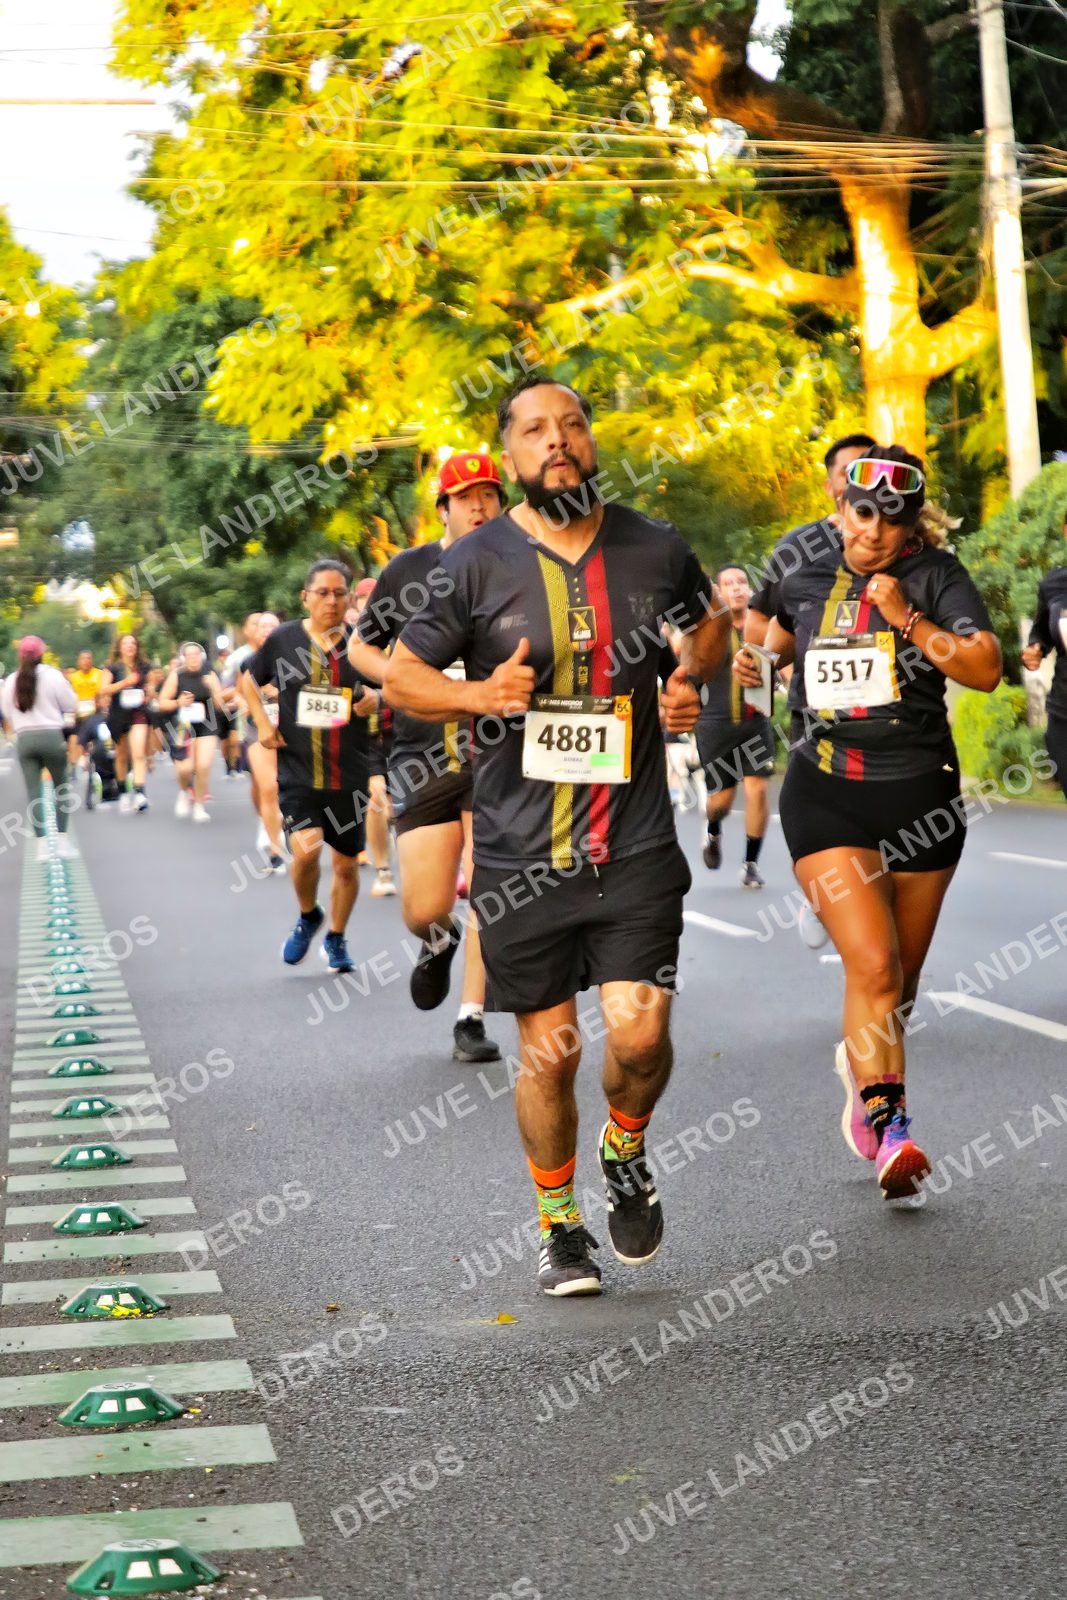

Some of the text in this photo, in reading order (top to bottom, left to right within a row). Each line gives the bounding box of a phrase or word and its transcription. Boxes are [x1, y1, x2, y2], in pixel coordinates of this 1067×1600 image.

[817, 658, 874, 683] 5517
[306, 698, 339, 713] 5843
[537, 724, 607, 753] 4881
